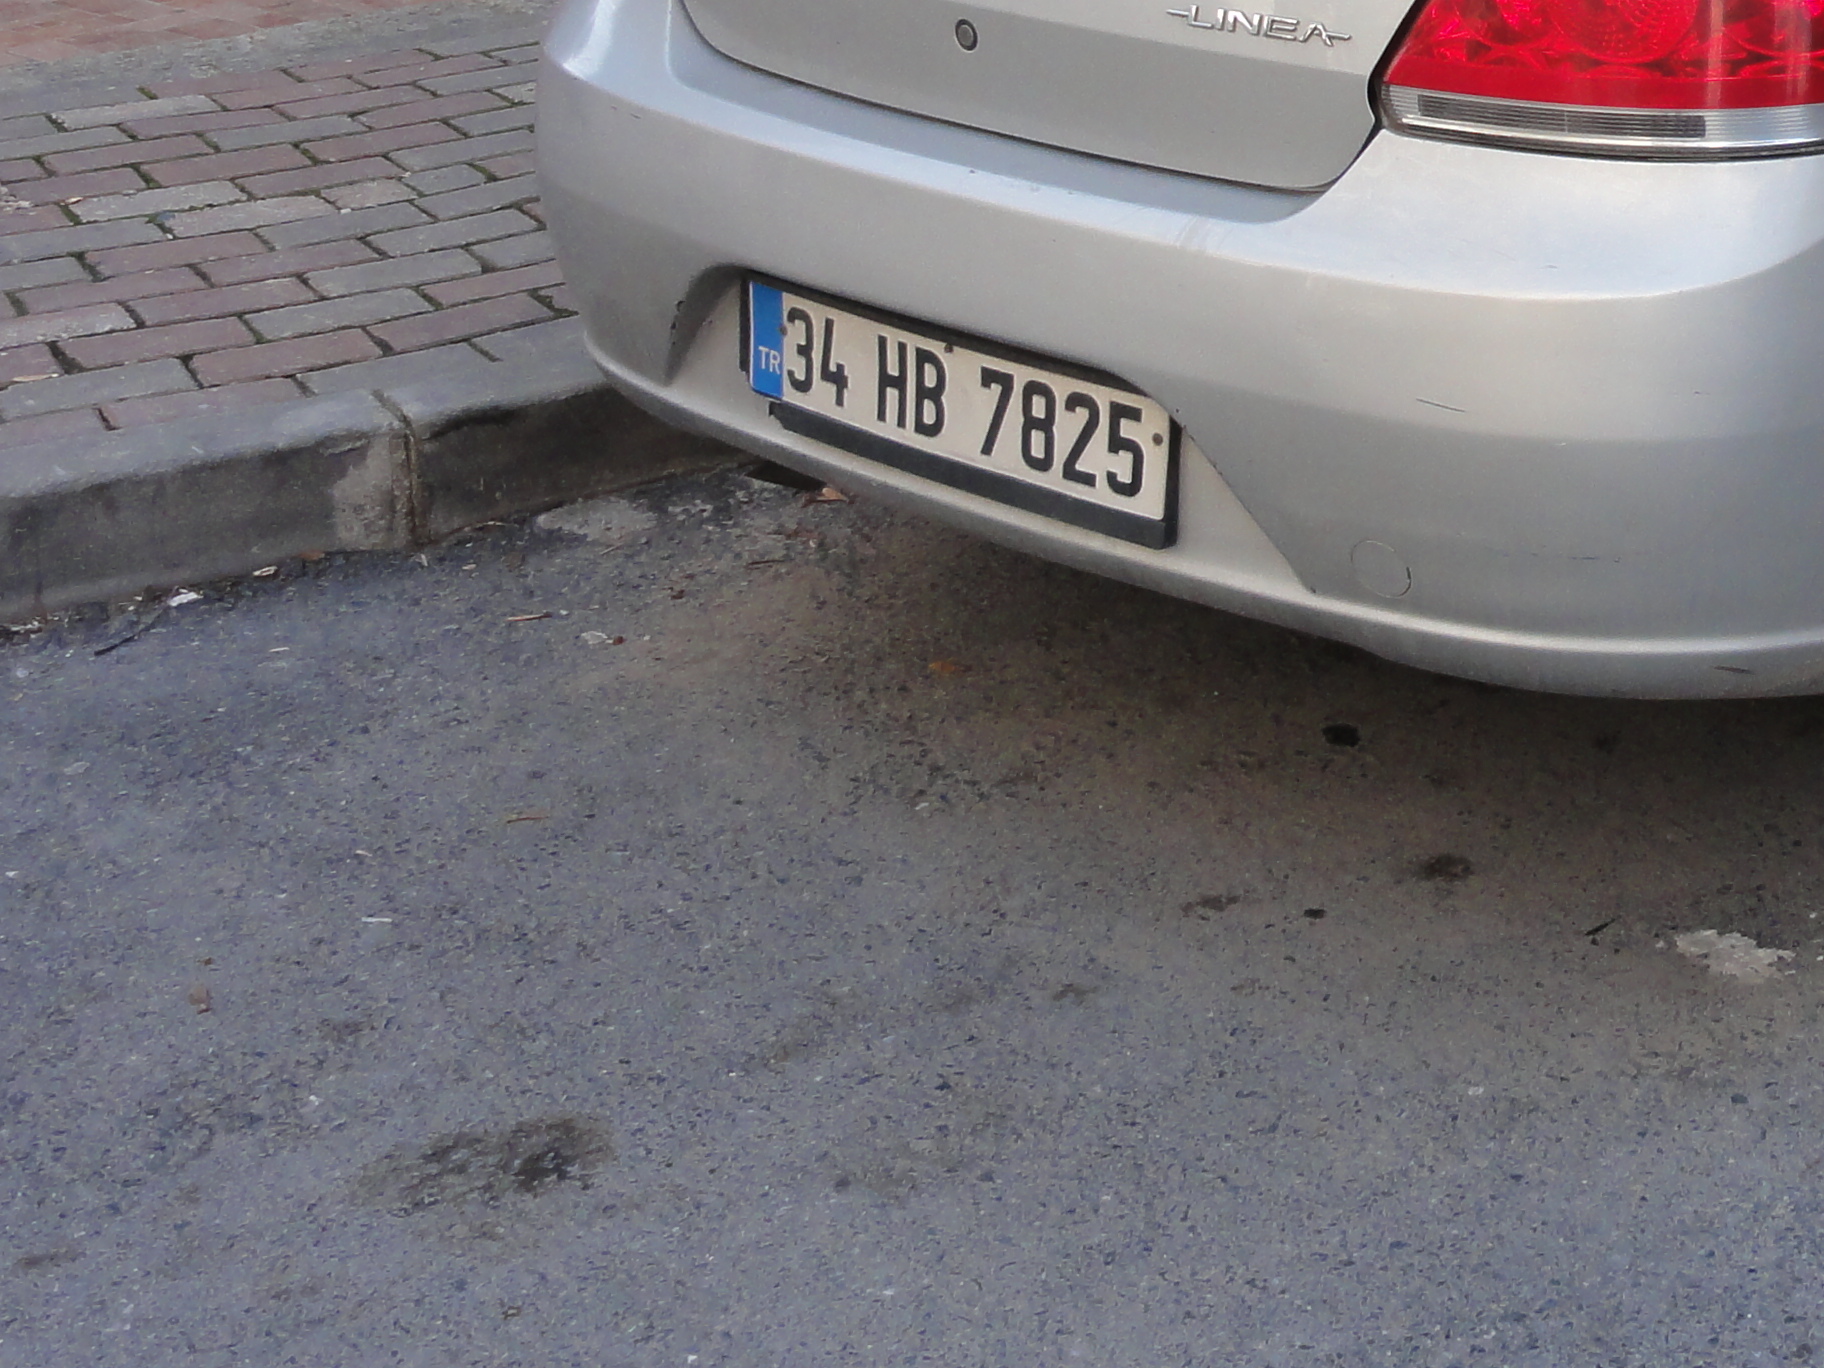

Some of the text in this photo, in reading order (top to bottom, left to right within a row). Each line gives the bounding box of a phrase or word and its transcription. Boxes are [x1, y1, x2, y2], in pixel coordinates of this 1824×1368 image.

[1180, 4, 1340, 47] LINEA
[759, 345, 781, 375] TR
[787, 306, 1144, 498] 34 HB 7825
